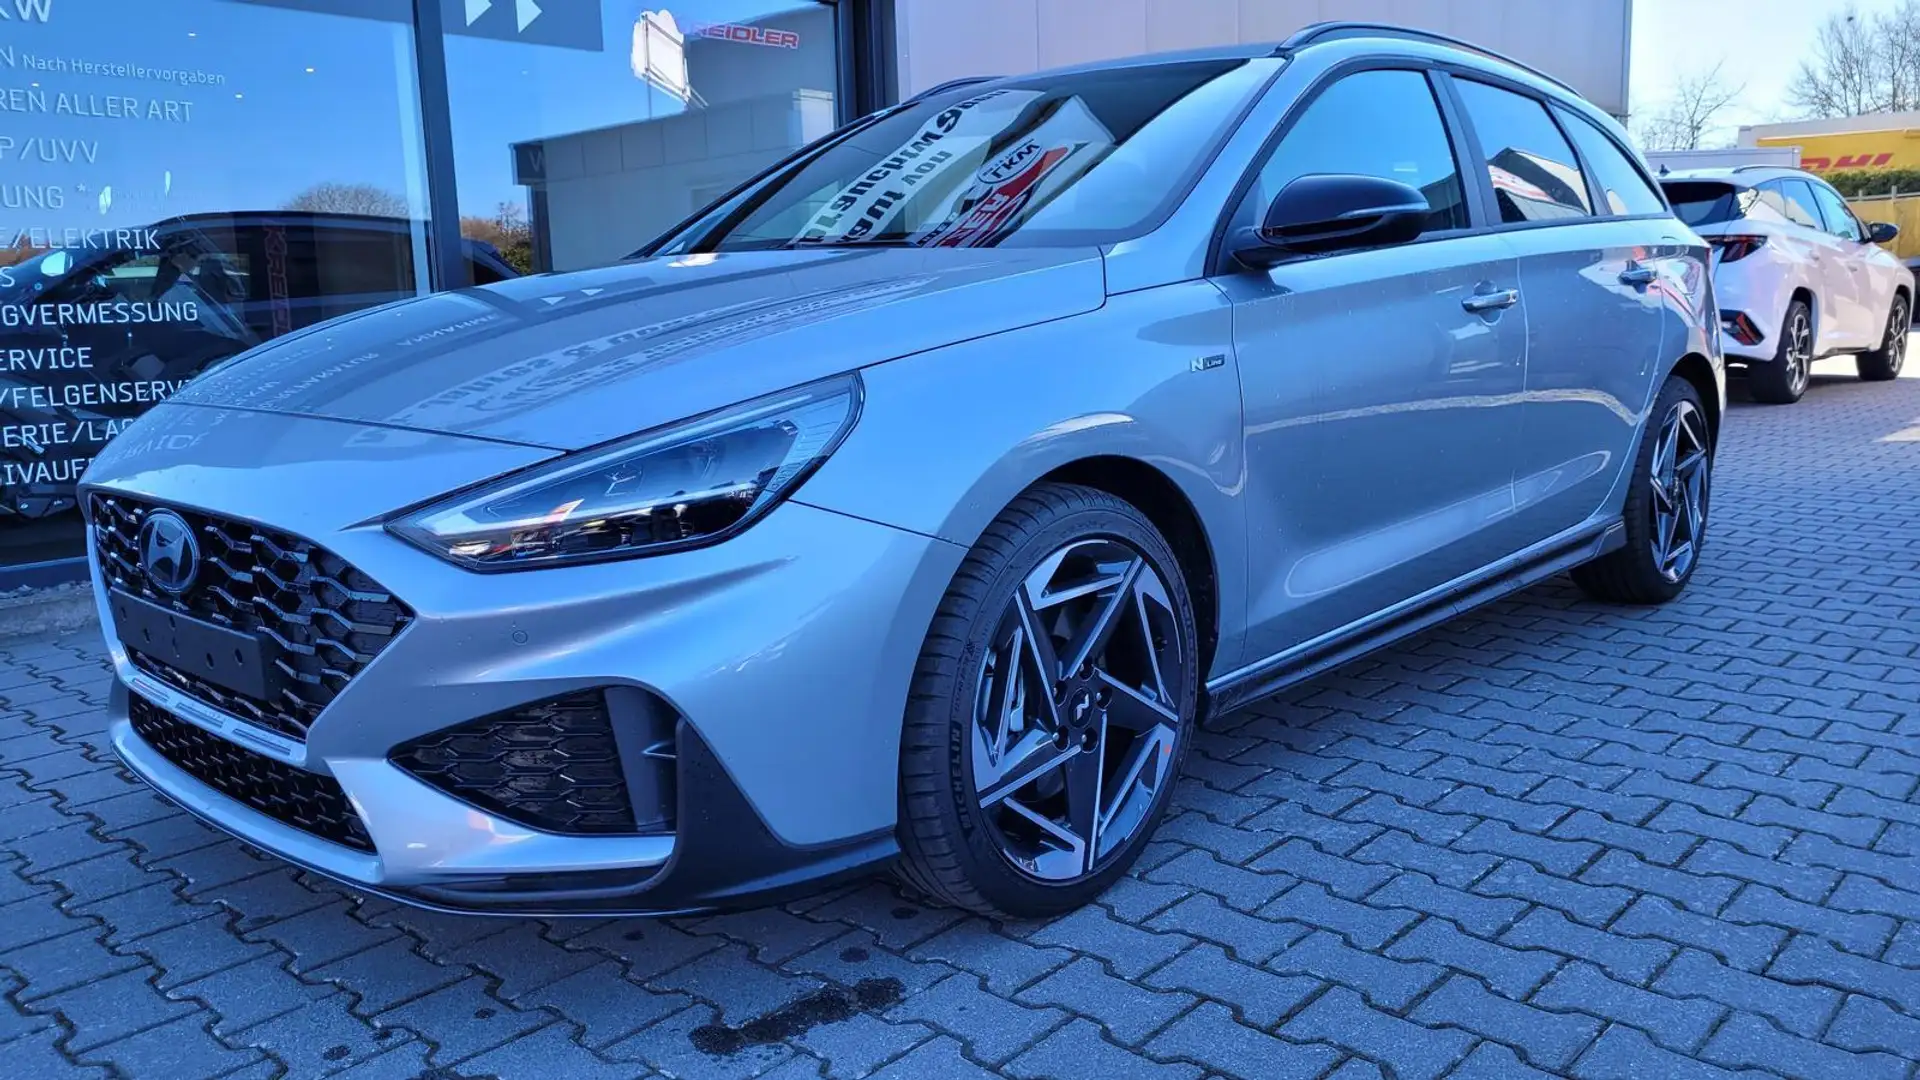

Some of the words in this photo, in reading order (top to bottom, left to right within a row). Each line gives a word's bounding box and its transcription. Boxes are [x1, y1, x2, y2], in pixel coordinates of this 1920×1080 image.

[23, 53, 66, 72] Nach
[72, 59, 226, 86] Herstellervorgaben
[56, 92, 139, 119] ALLER
[148, 99, 194, 123] ART
[2, 184, 65, 210] UNG
[1, 265, 16, 288] S
[2, 301, 199, 327] GVERMESSUNG
[0, 380, 191, 409] /FELGENSERV
[0, 456, 95, 486] IVAUF
